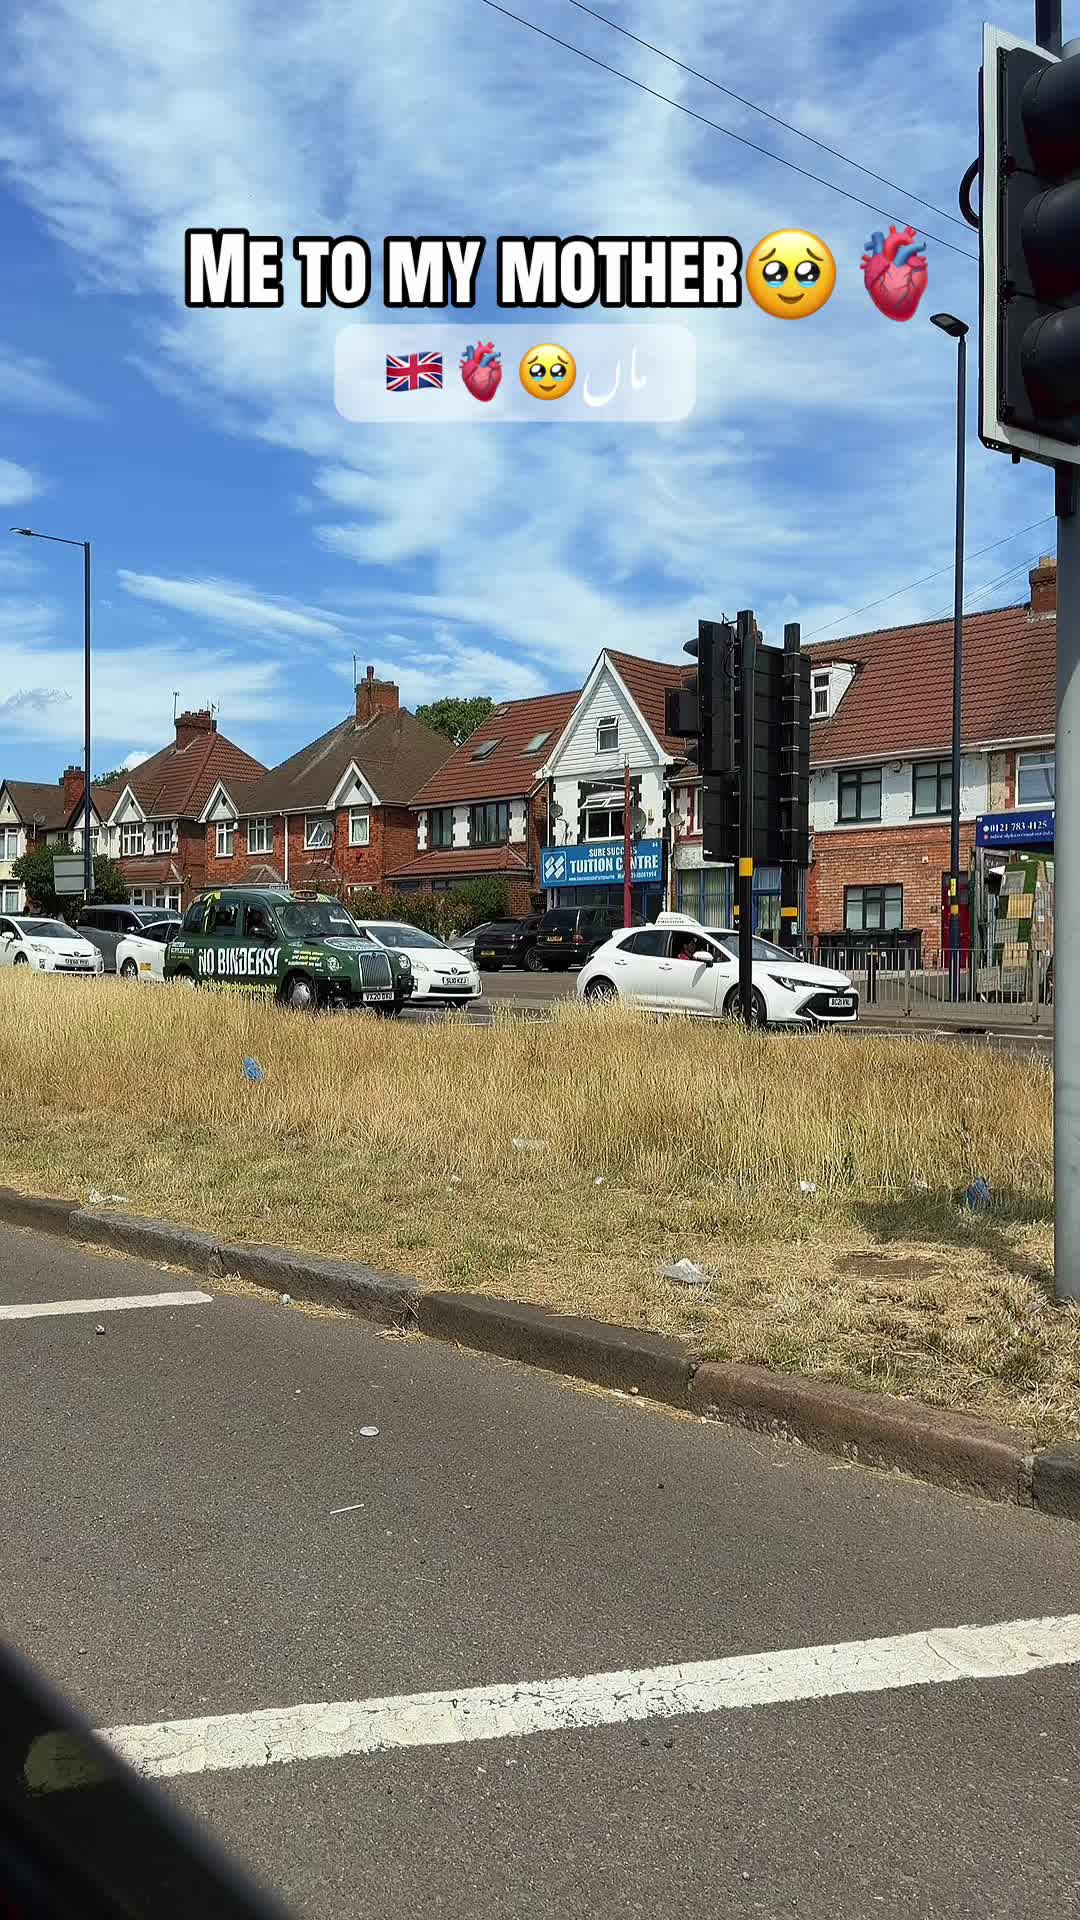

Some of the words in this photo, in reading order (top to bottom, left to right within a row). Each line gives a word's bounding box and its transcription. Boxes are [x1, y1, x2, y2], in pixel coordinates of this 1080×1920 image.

[990, 824, 1008, 832] 0121
[1011, 822, 1026, 831] 783
[588, 847, 606, 858] SURE
[569, 858, 613, 874] TUITION
[615, 855, 659, 871] CNTRE
[198, 947, 215, 976] NO
[217, 946, 282, 976] BINDERS!
